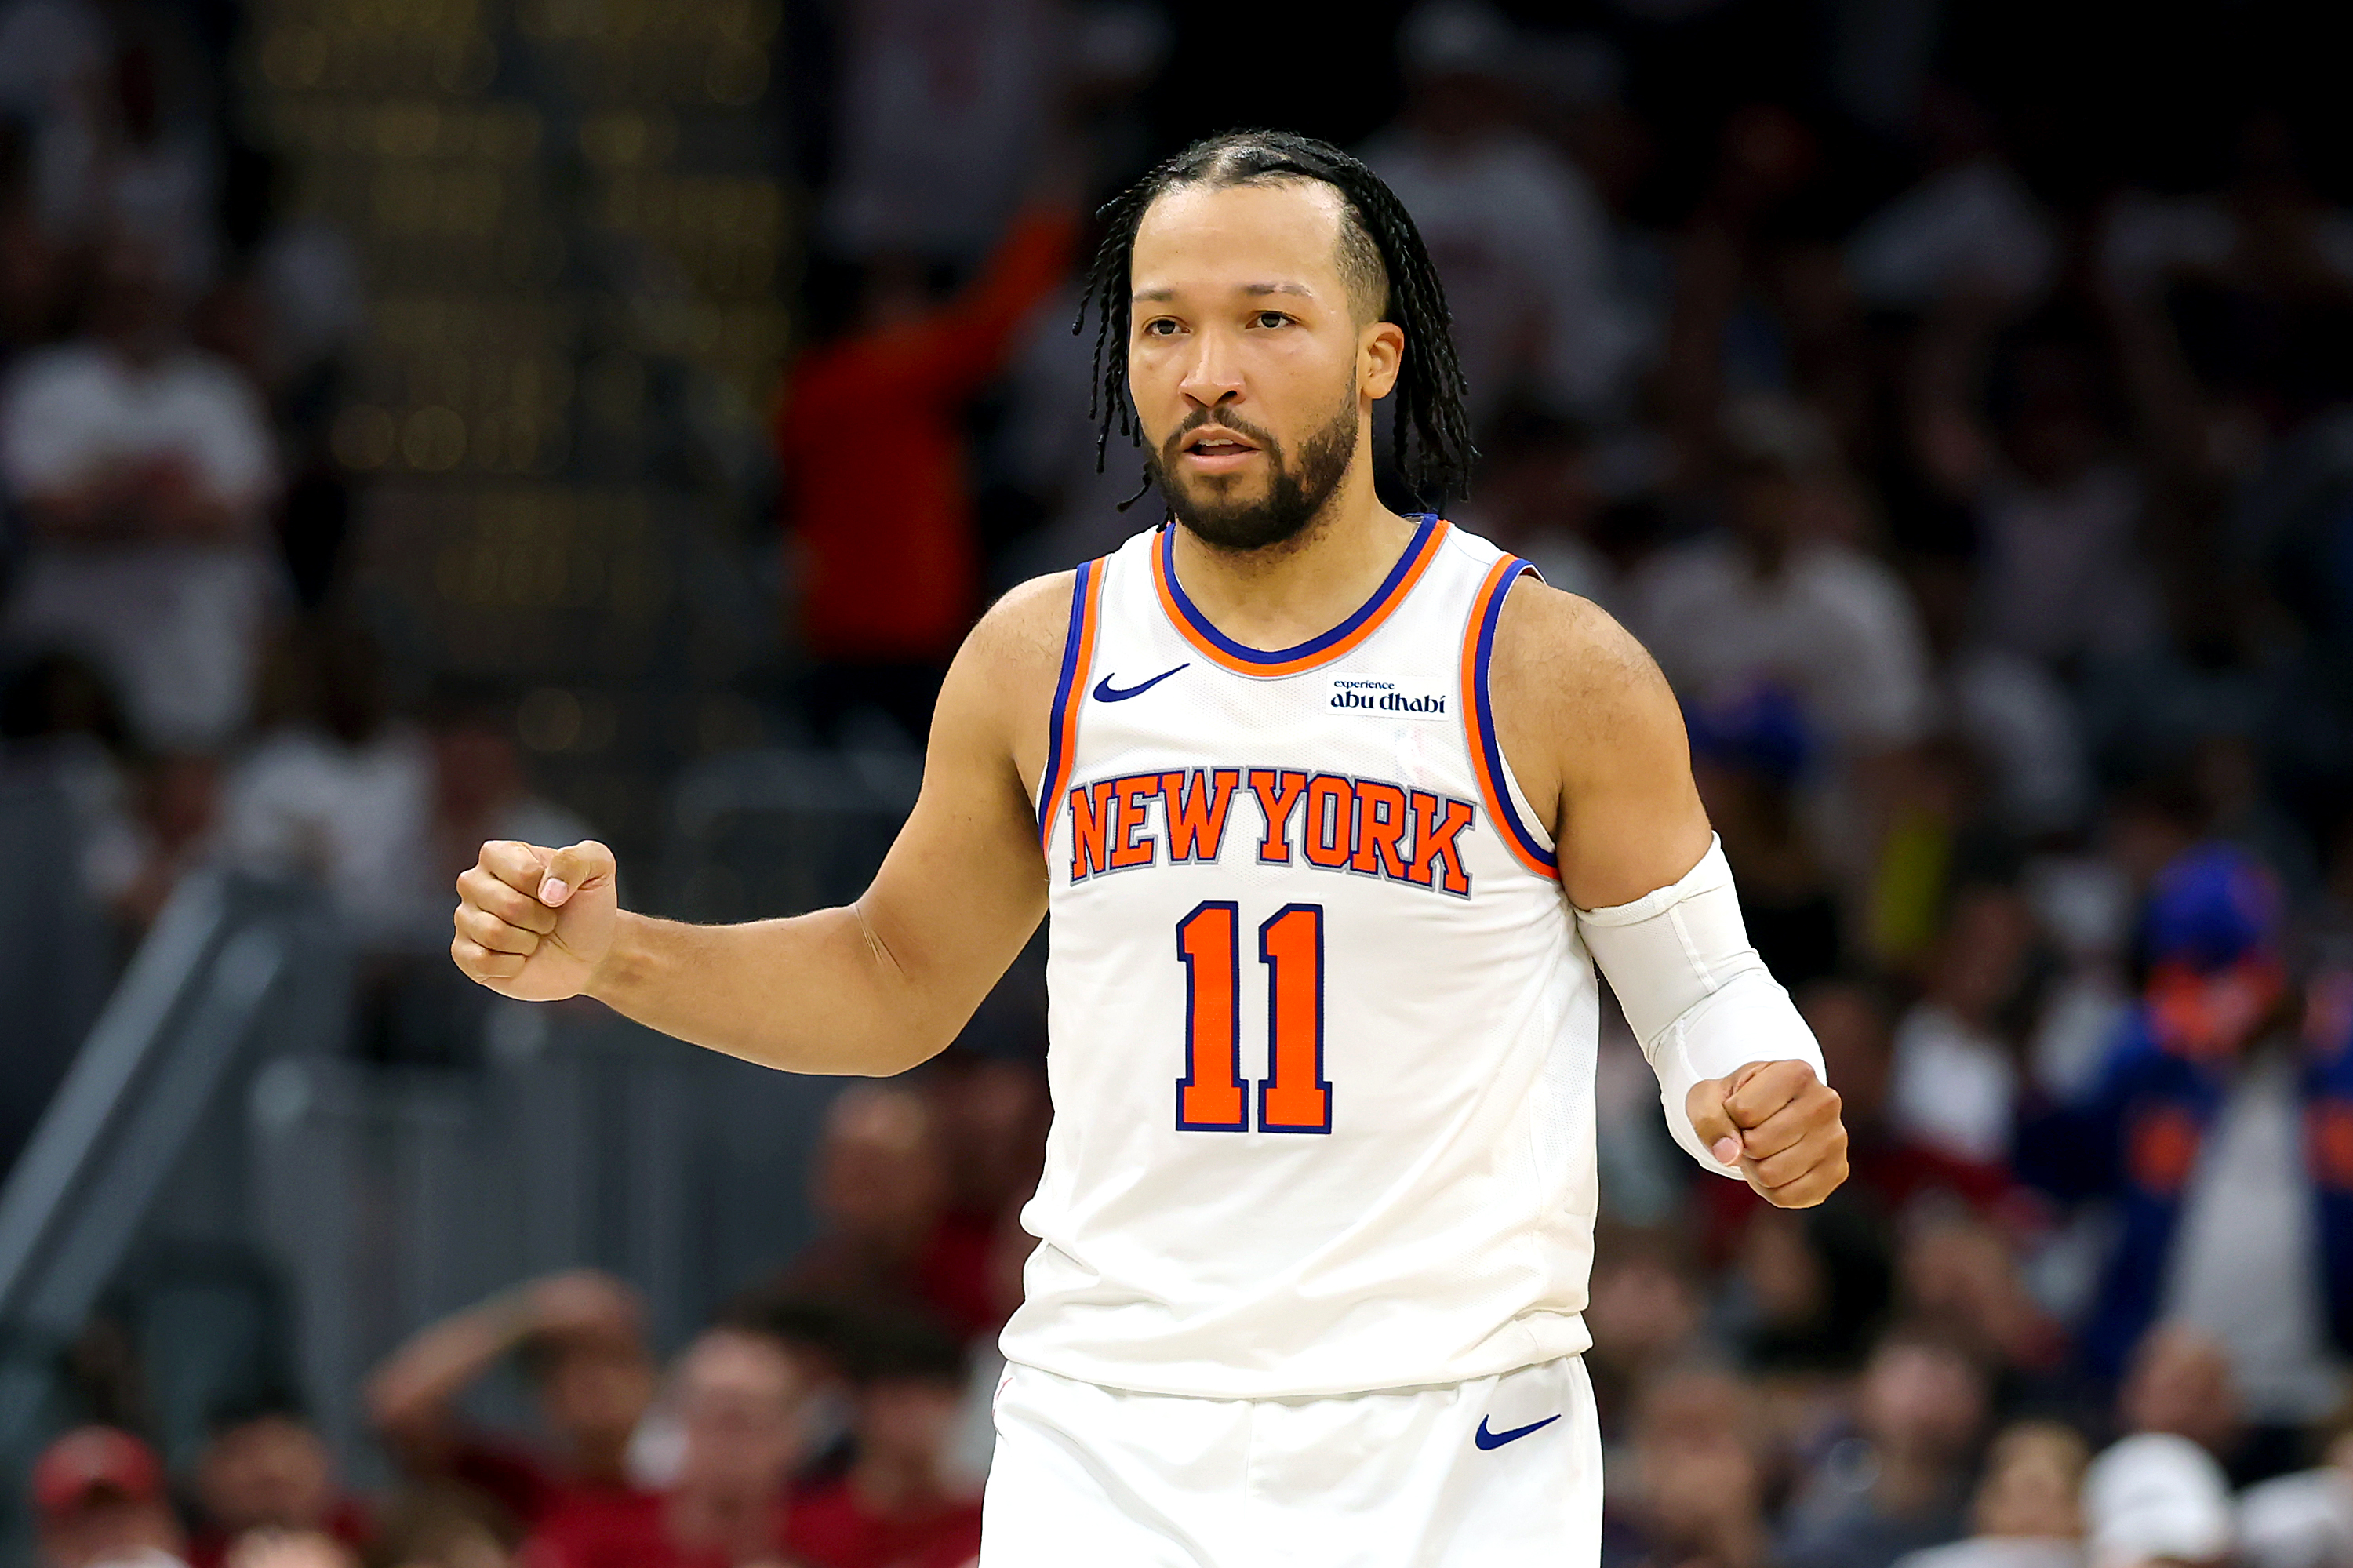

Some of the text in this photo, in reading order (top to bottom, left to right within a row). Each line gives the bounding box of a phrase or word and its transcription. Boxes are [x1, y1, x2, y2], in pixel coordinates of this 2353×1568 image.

[1330, 690, 1447, 714] abu dhabi
[1333, 679, 1395, 690] experience
[1068, 766, 1476, 900] NEW YORK
[1176, 900, 1333, 1134] 11
